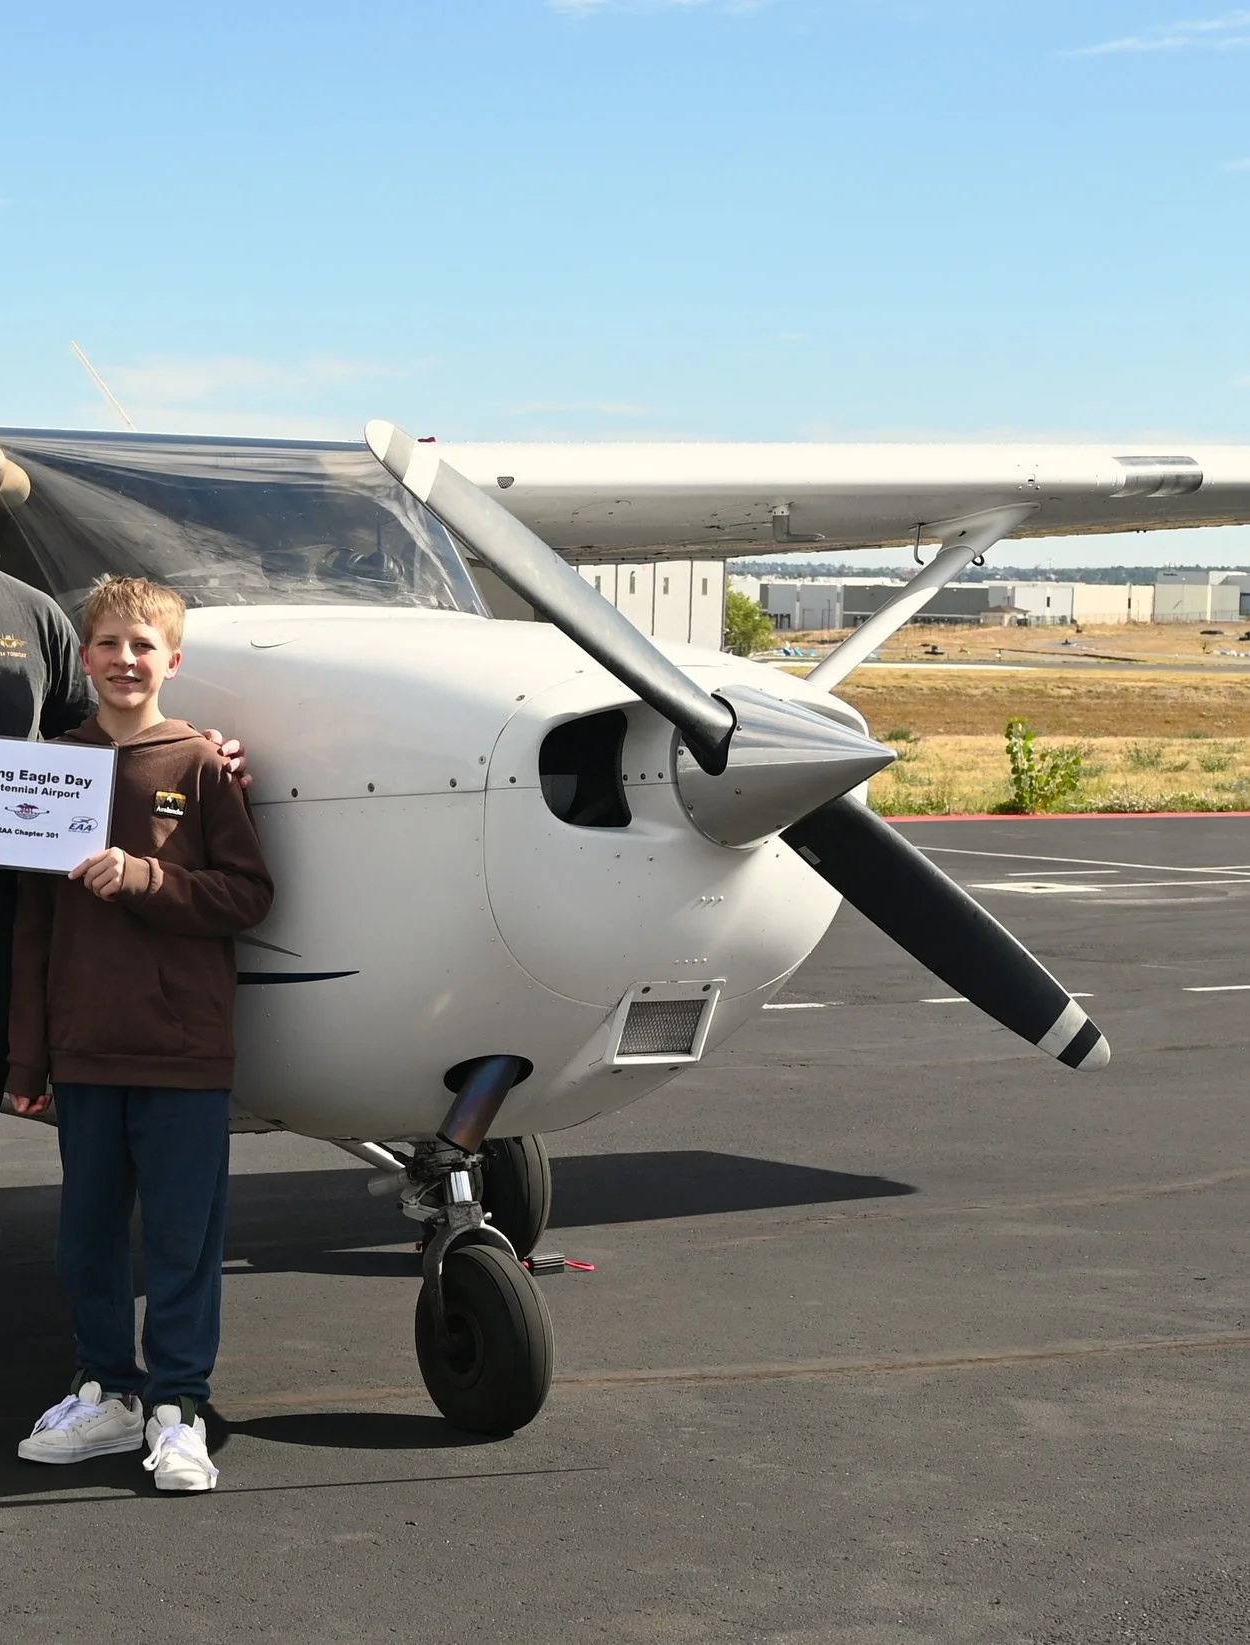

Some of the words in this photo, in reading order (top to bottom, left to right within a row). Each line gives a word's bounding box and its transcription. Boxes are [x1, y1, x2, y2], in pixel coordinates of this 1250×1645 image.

[19, 770, 60, 785] Eagle
[65, 774, 92, 789] Day
[41, 788, 80, 799] Airport
[68, 823, 92, 831] EAA
[14, 829, 44, 837] Chapter
